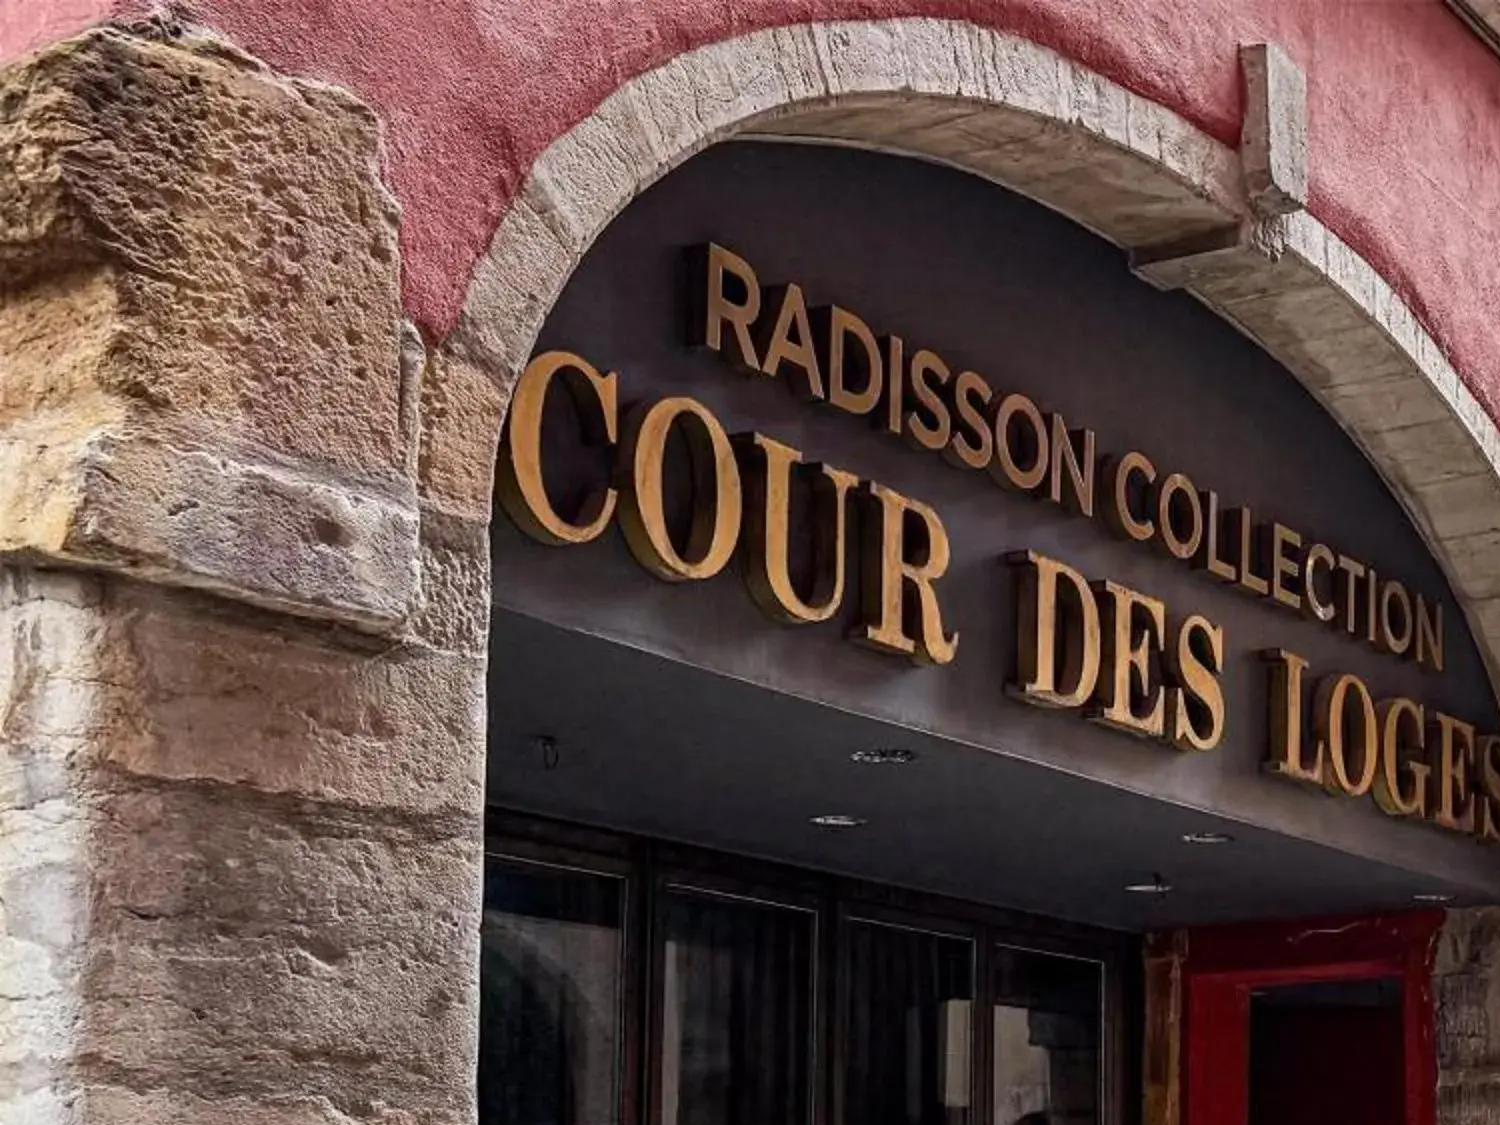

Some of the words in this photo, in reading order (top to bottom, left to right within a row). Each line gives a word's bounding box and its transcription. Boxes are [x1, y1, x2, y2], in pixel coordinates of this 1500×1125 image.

[506, 349, 960, 666] COUR
[1022, 549, 1225, 753] DES
[704, 241, 1096, 518] RADISSON
[1114, 451, 1444, 672] COLLECTION
